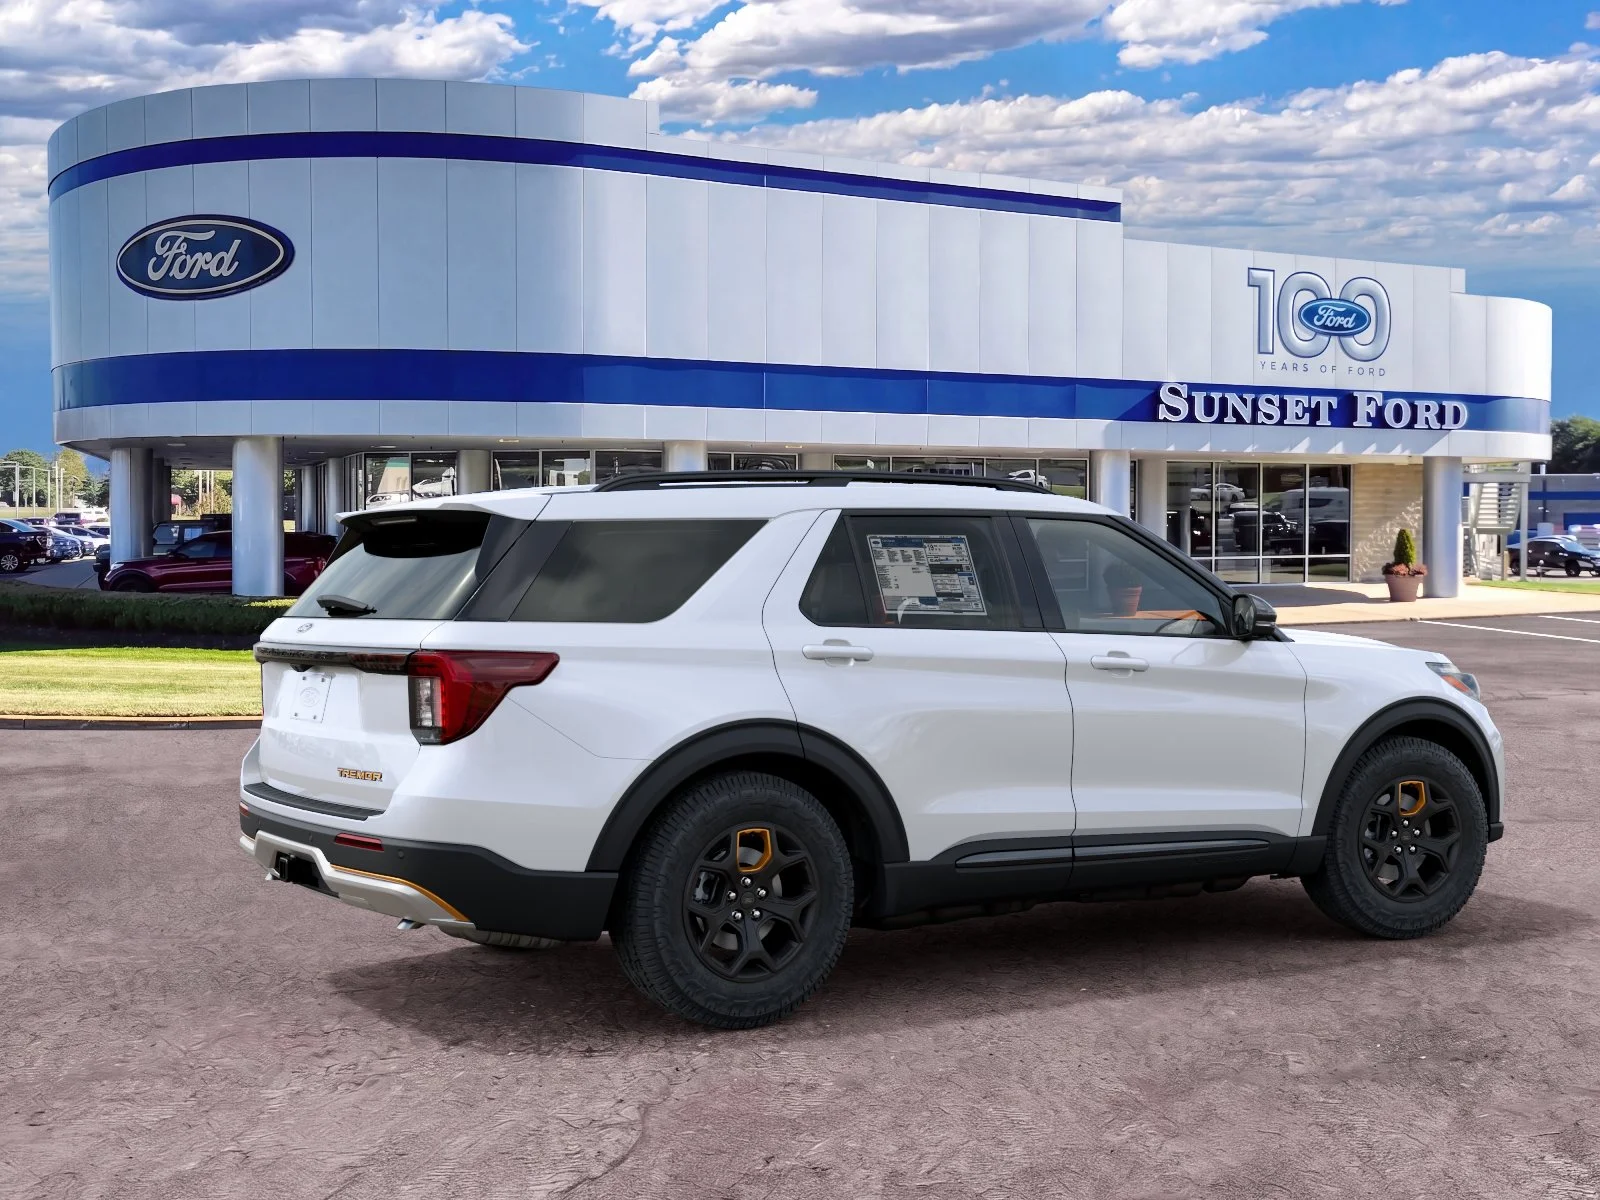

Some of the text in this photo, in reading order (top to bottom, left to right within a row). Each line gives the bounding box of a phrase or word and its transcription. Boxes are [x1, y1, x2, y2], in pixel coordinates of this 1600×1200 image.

[148, 230, 241, 281] Ford
[1247, 266, 1392, 363] 100
[1313, 305, 1357, 328] Ford
[1259, 361, 1386, 377] YEARS OF FORD
[1157, 382, 1468, 430] SUNSET FORD
[337, 768, 383, 782] TREMOR
